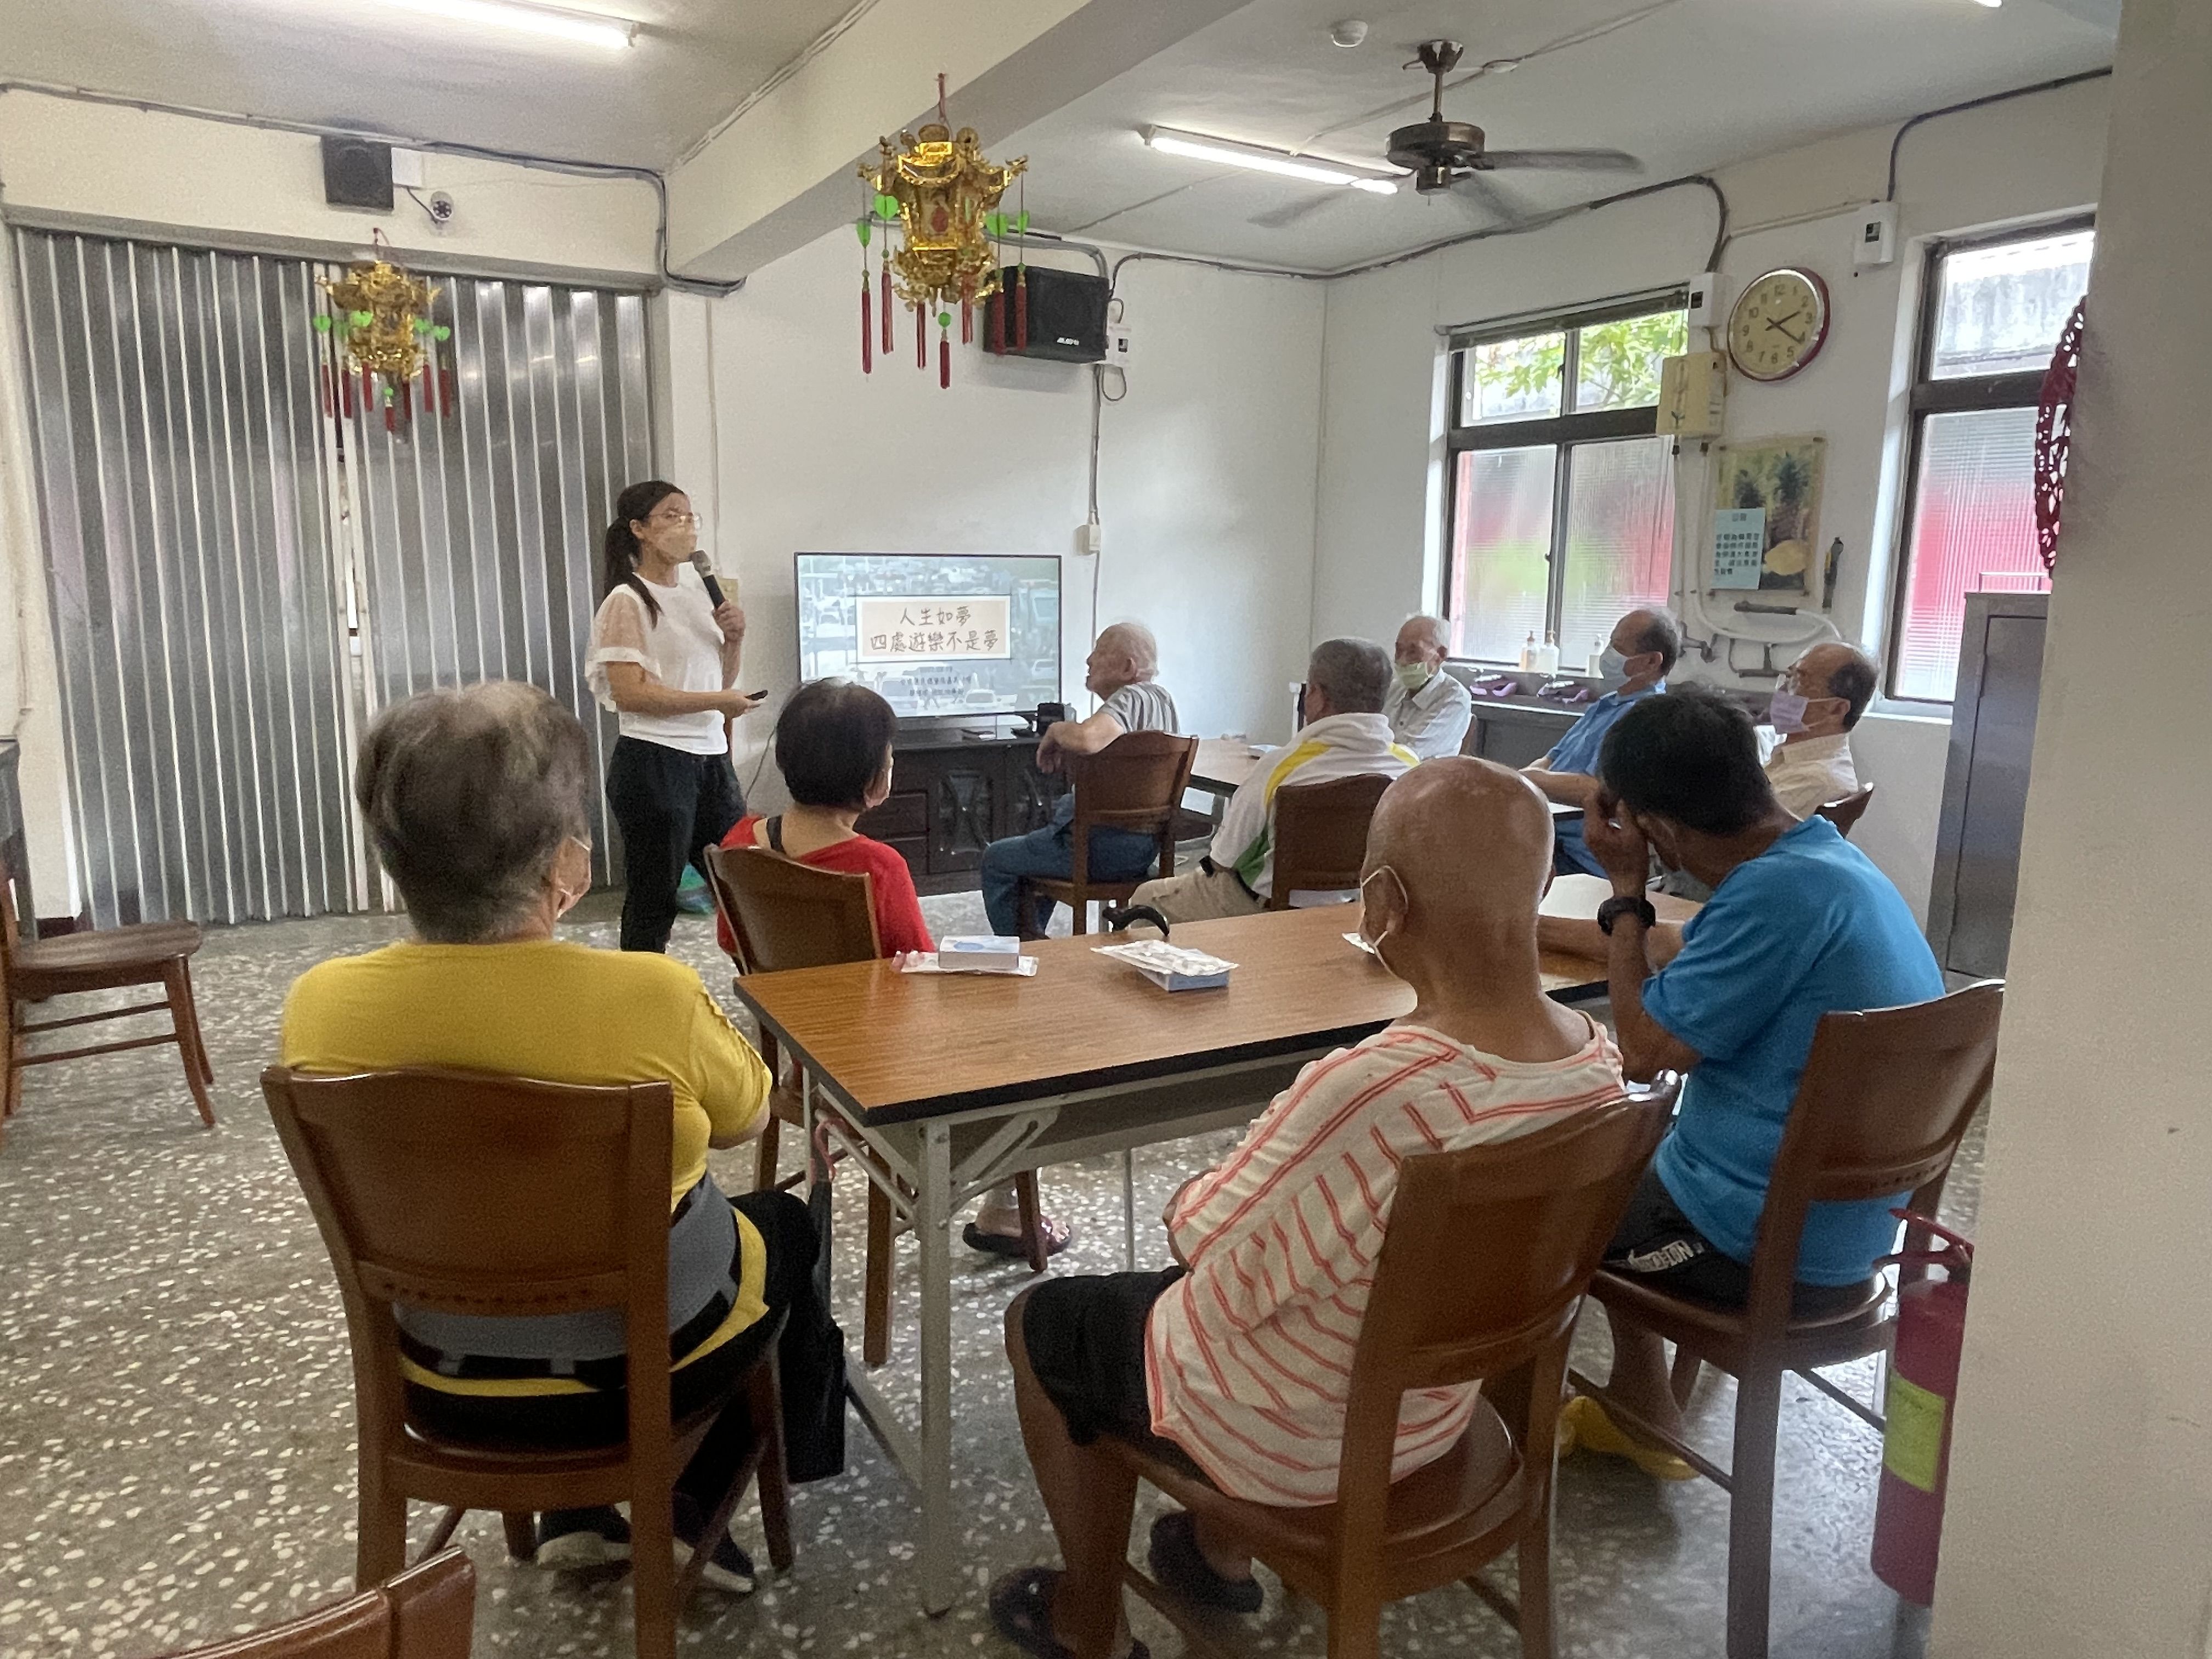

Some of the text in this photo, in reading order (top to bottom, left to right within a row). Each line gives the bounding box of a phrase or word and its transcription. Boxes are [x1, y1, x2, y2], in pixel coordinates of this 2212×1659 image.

[1774, 284, 1785, 296] 12
[1802, 296, 1808, 307] 2
[1749, 307, 1759, 318] 10
[1805, 312, 1813, 324] 3
[1742, 325, 1750, 336] 9
[1786, 346, 1794, 358] 5
[900, 605, 971, 627] 人生如夢
[870, 630, 998, 652] 四處遊樂不是夢
